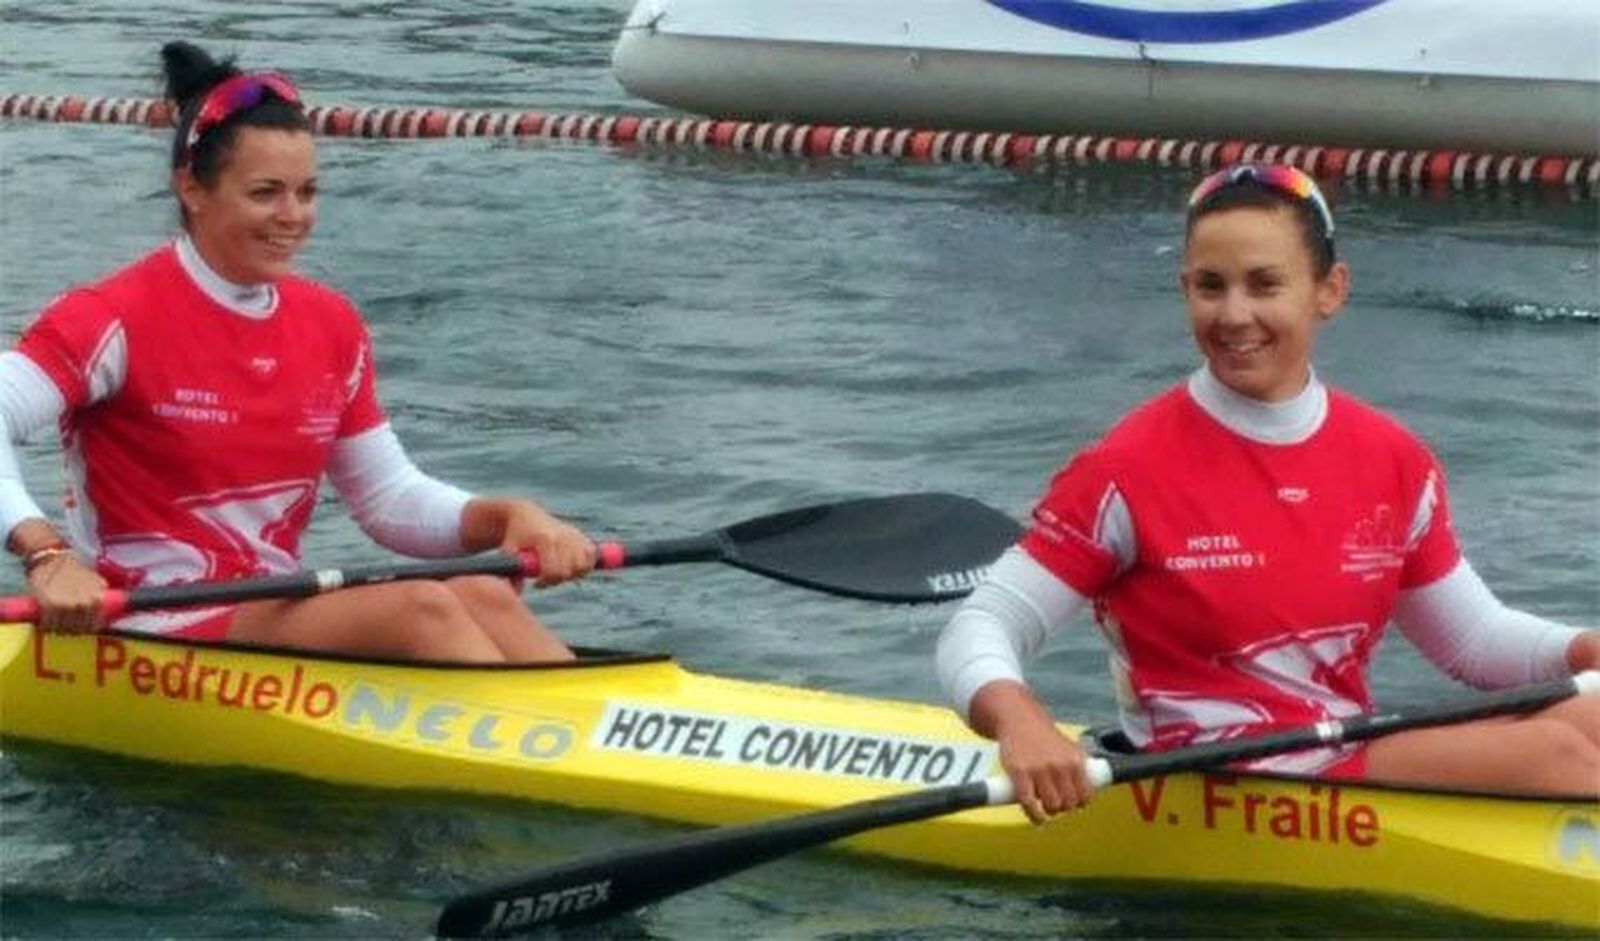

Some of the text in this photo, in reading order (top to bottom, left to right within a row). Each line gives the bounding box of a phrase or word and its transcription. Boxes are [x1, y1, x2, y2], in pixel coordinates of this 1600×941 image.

[1165, 553, 1253, 570] CONVENTO
[1187, 535, 1240, 551] HOTEL
[32, 630, 338, 718] L. Pedruelo
[602, 707, 729, 758] HOTEL
[739, 725, 956, 785] CONVENTO
[1128, 773, 1381, 848] V. Fraile
